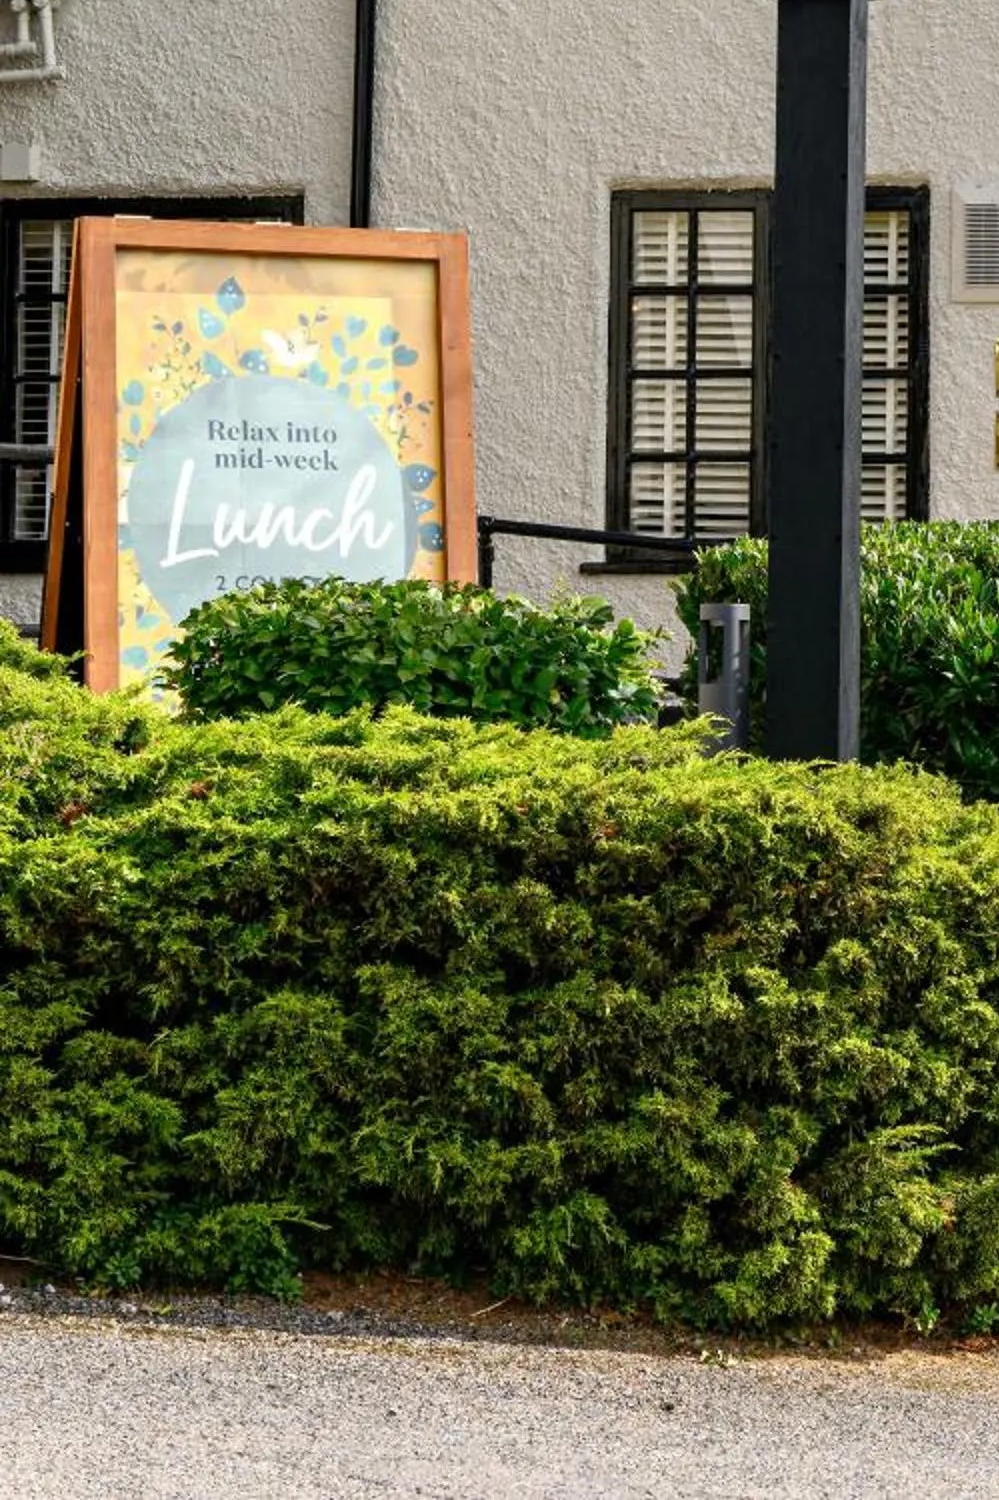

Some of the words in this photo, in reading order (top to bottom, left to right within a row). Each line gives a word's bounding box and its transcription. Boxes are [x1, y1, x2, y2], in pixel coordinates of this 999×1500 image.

[206, 418, 279, 443] Relax
[286, 421, 338, 445] into
[215, 448, 339, 472] mid-week
[159, 459, 395, 568] Lunch
[215, 575, 227, 591] 2
